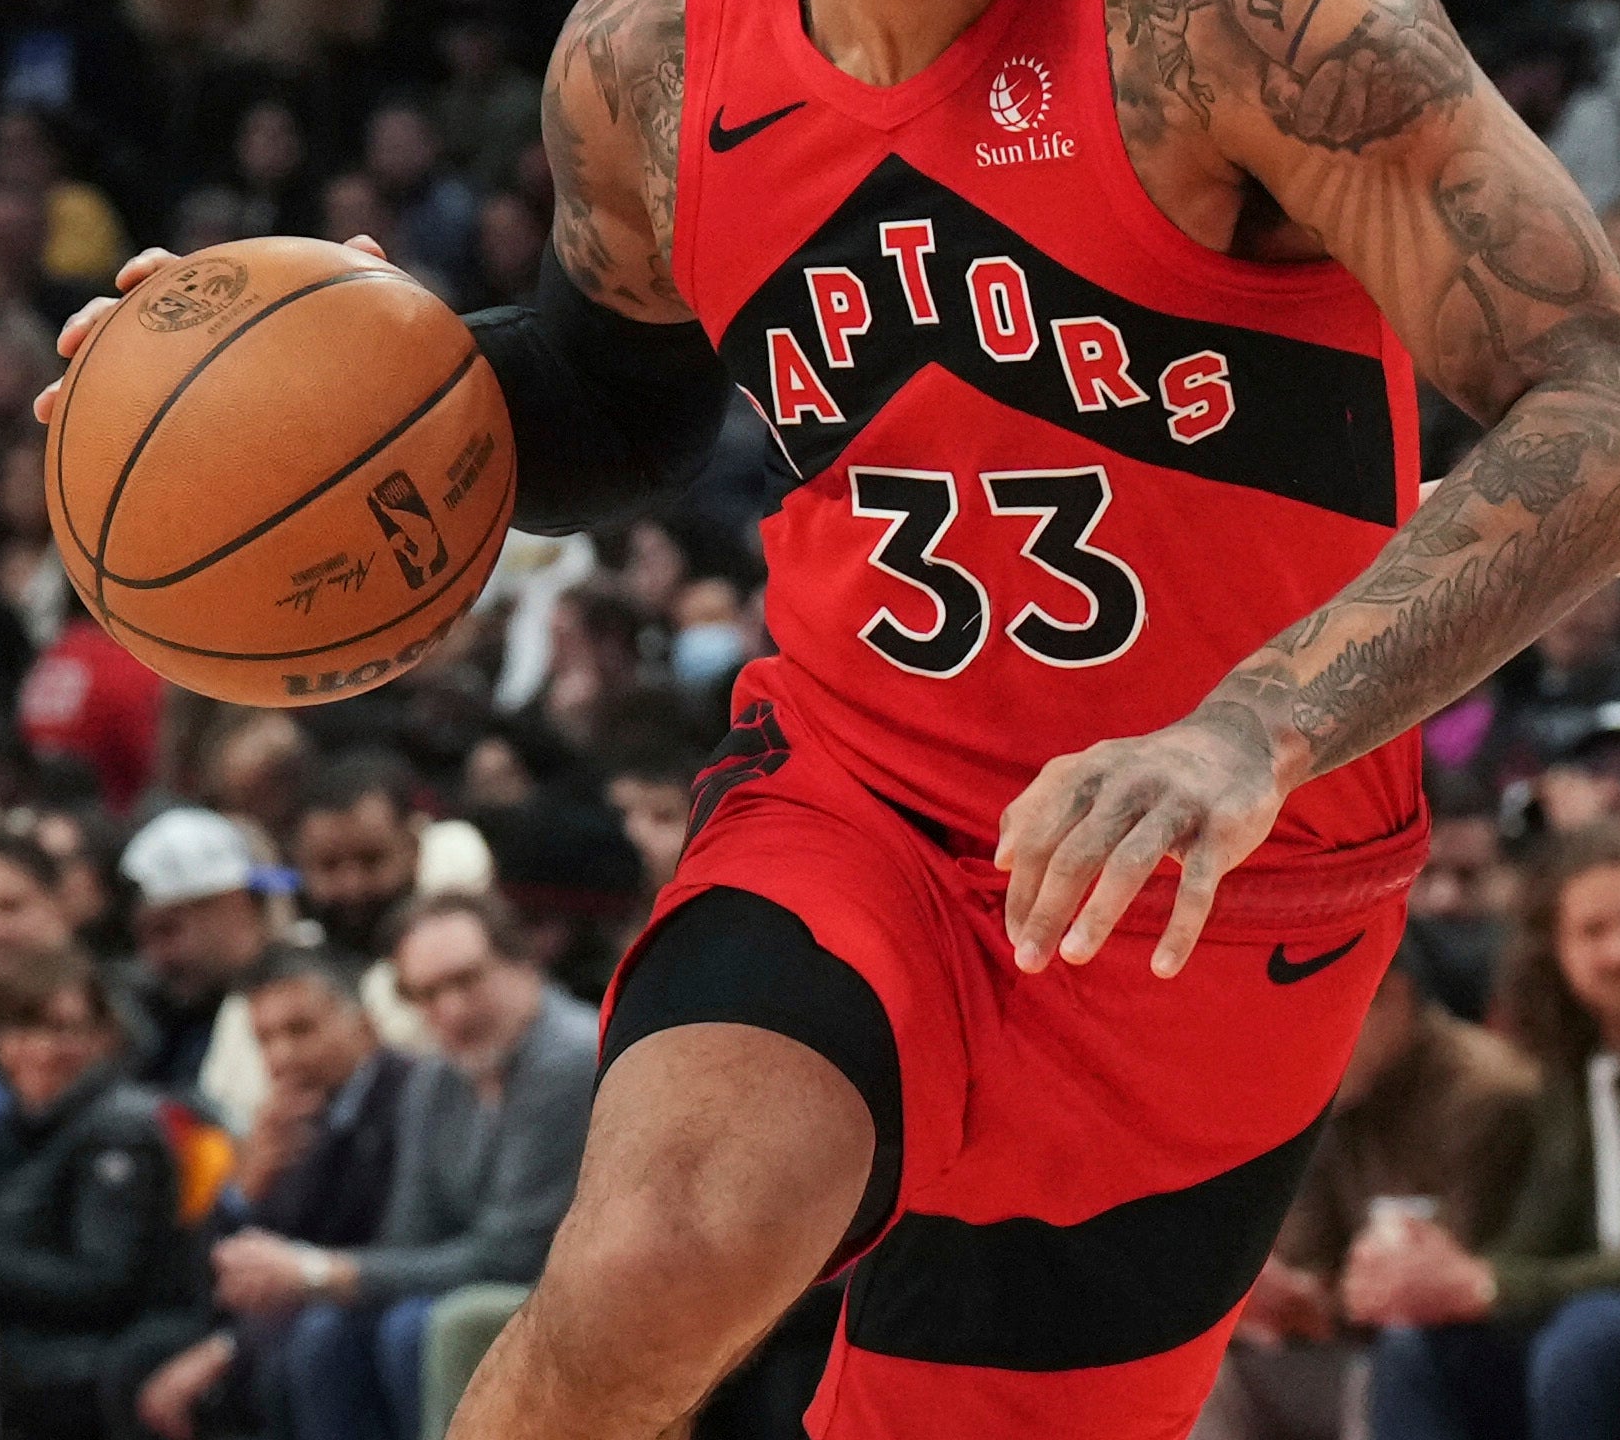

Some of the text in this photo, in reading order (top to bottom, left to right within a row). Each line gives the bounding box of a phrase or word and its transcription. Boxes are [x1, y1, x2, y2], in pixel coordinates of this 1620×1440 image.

[975, 130, 1076, 167] Sun Life
[760, 218, 1236, 446] APTORS
[847, 464, 1147, 680] 33
